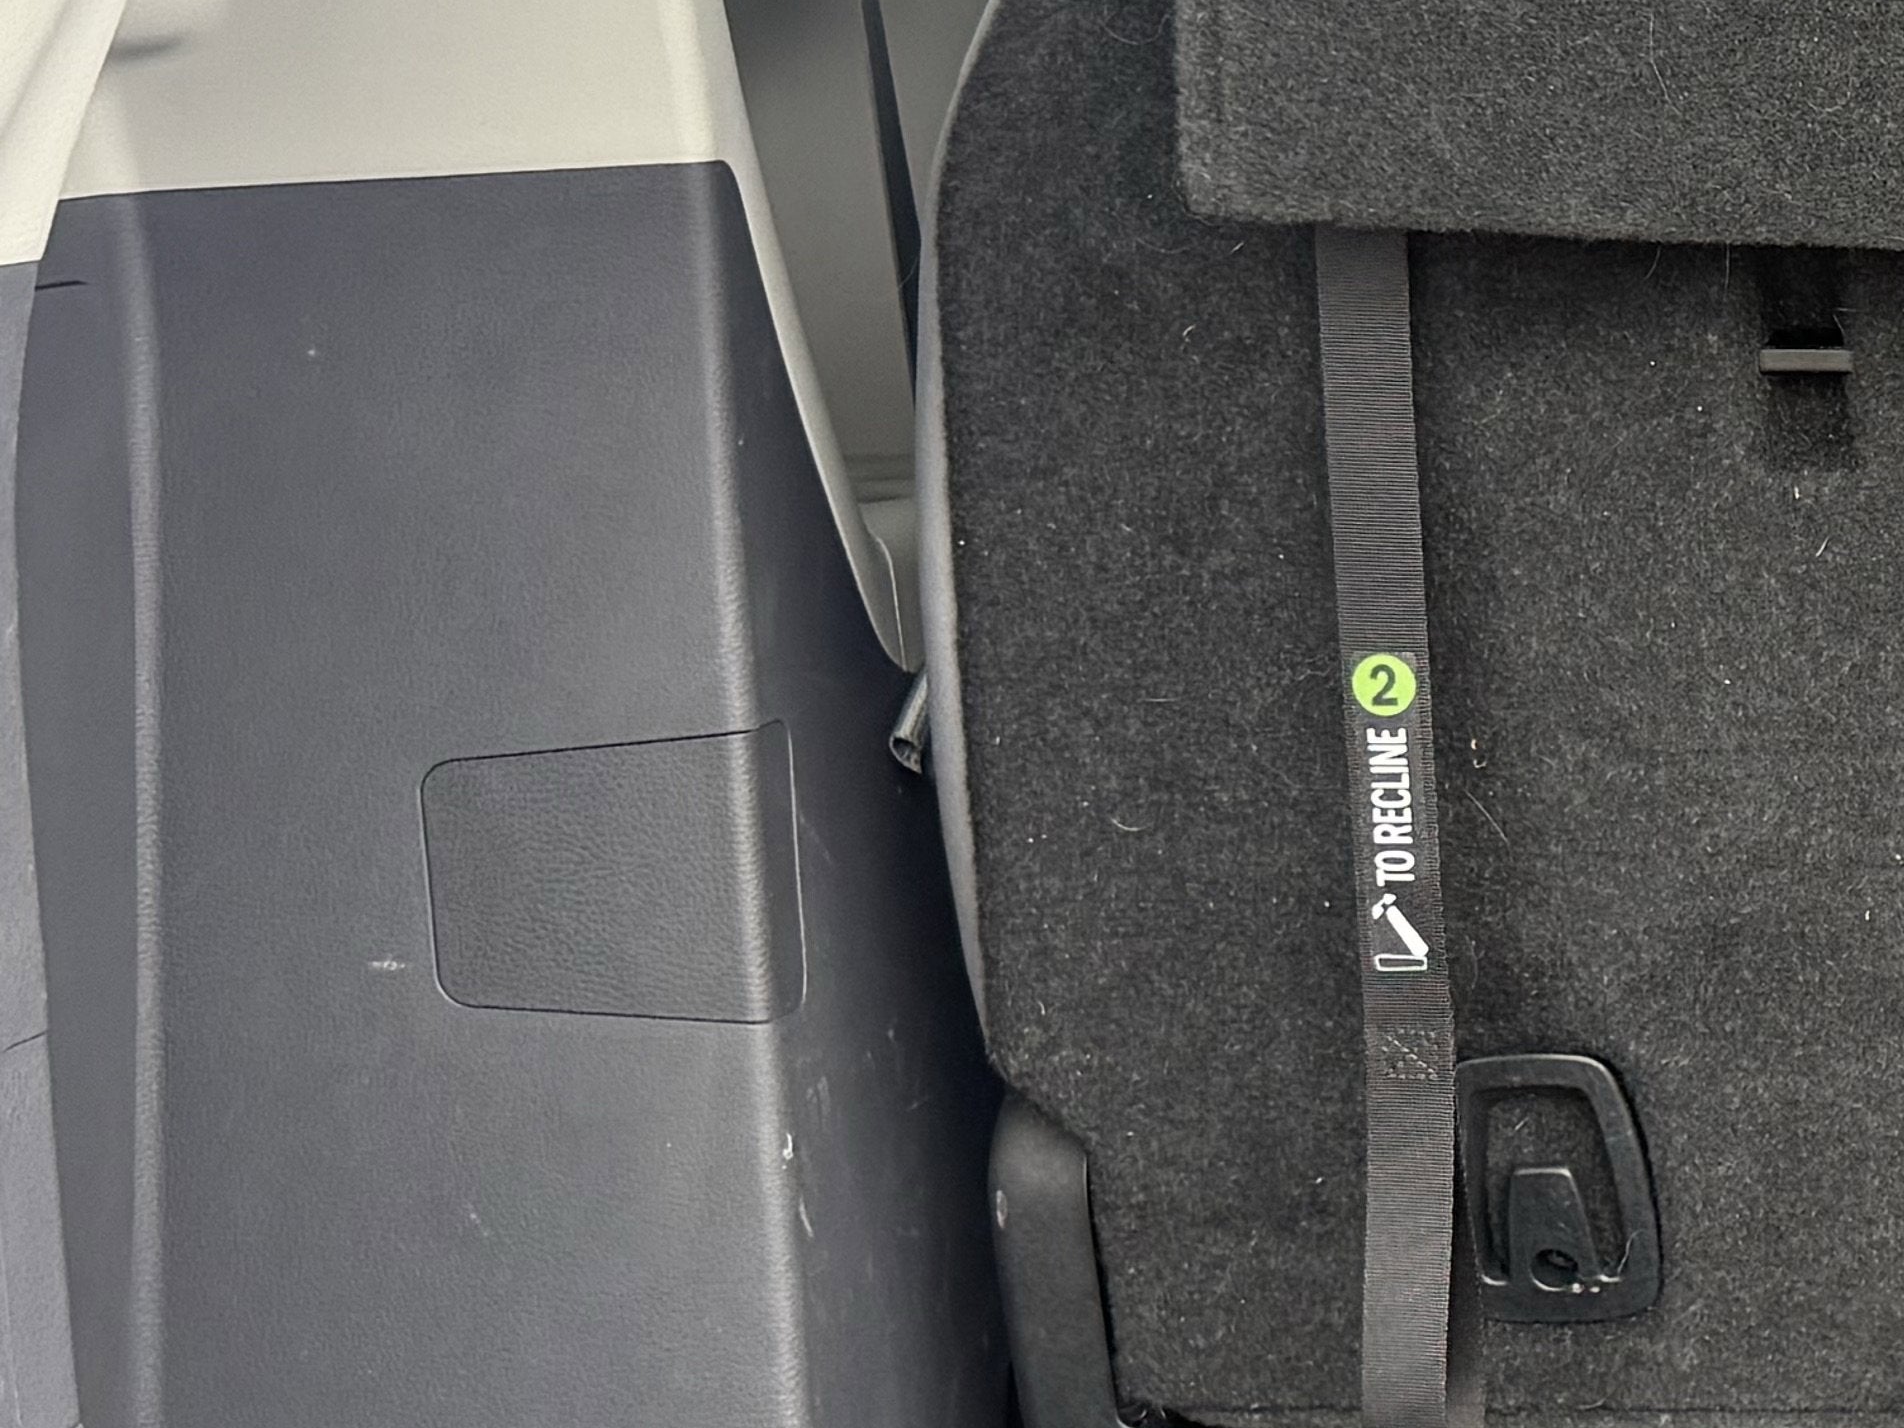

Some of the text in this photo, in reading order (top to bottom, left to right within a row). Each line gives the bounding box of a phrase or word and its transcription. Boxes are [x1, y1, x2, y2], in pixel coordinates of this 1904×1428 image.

[1369, 663, 1399, 707] 2
[1366, 727, 1416, 887] TO RECLINE
